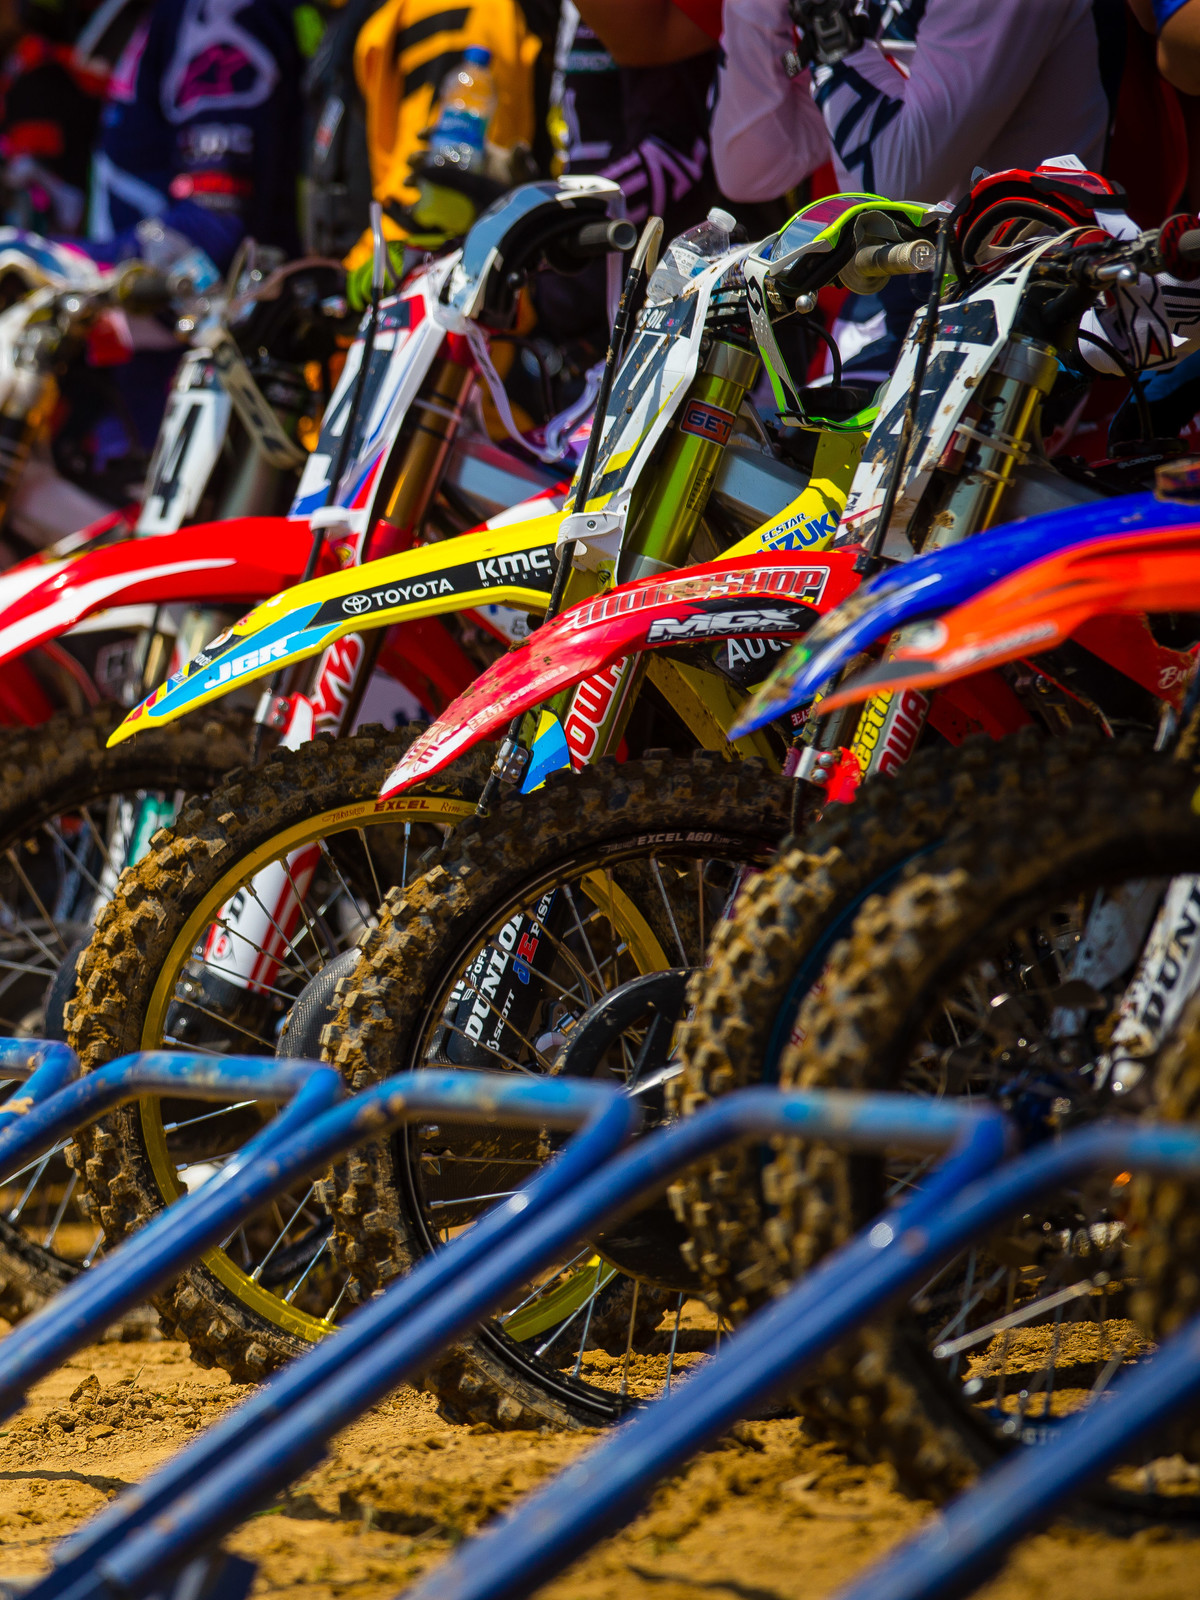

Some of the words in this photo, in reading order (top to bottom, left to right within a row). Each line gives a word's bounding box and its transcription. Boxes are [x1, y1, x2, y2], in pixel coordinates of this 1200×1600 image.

[687, 408, 732, 437] GET
[761, 512, 806, 543] ECSTAR
[372, 577, 455, 607] TOYOTA
[481, 568, 553, 588] WHEELS
[204, 632, 290, 690] JGR
[373, 799, 431, 813] EXCEL
[441, 801, 461, 813] Rim
[637, 832, 684, 846] EXCEL
[513, 932, 539, 985] JE
[493, 988, 516, 1041] SCOTT
